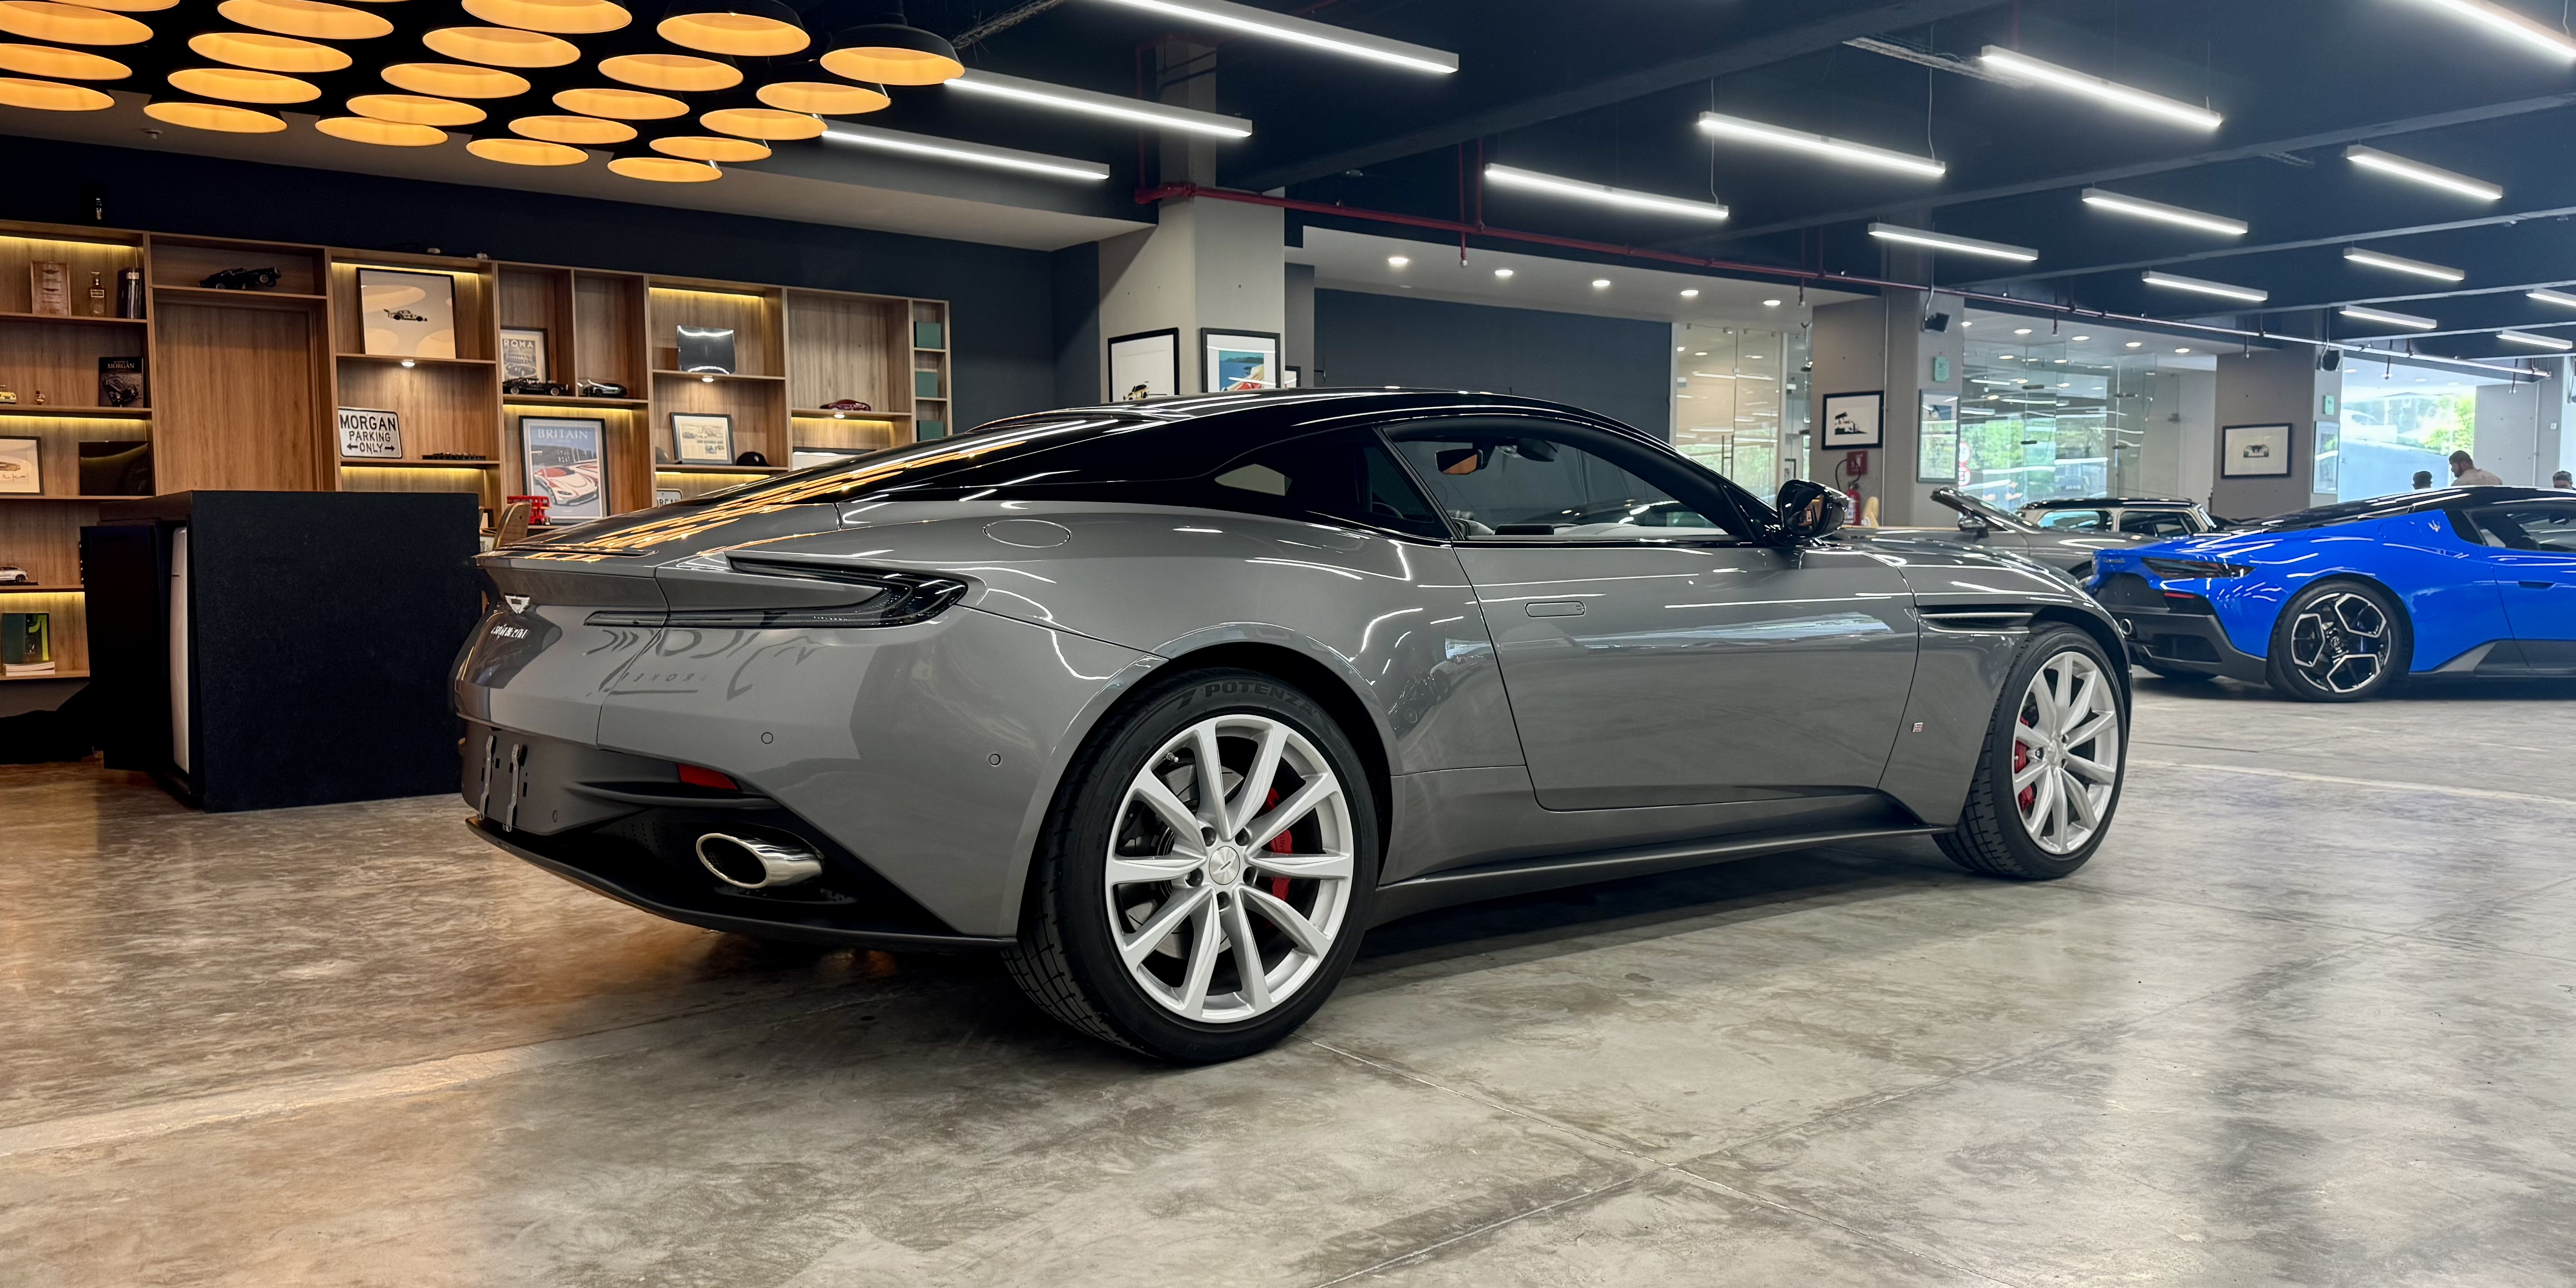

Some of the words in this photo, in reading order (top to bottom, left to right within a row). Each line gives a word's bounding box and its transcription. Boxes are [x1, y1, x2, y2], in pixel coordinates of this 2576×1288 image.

[504, 339, 534, 348] ROMA
[339, 414, 396, 431] MORGAN
[349, 431, 391, 442] PARKING
[538, 429, 588, 439] BRITAIN
[359, 442, 382, 454] ONLY
[1205, 681, 1313, 717] POTENZA
